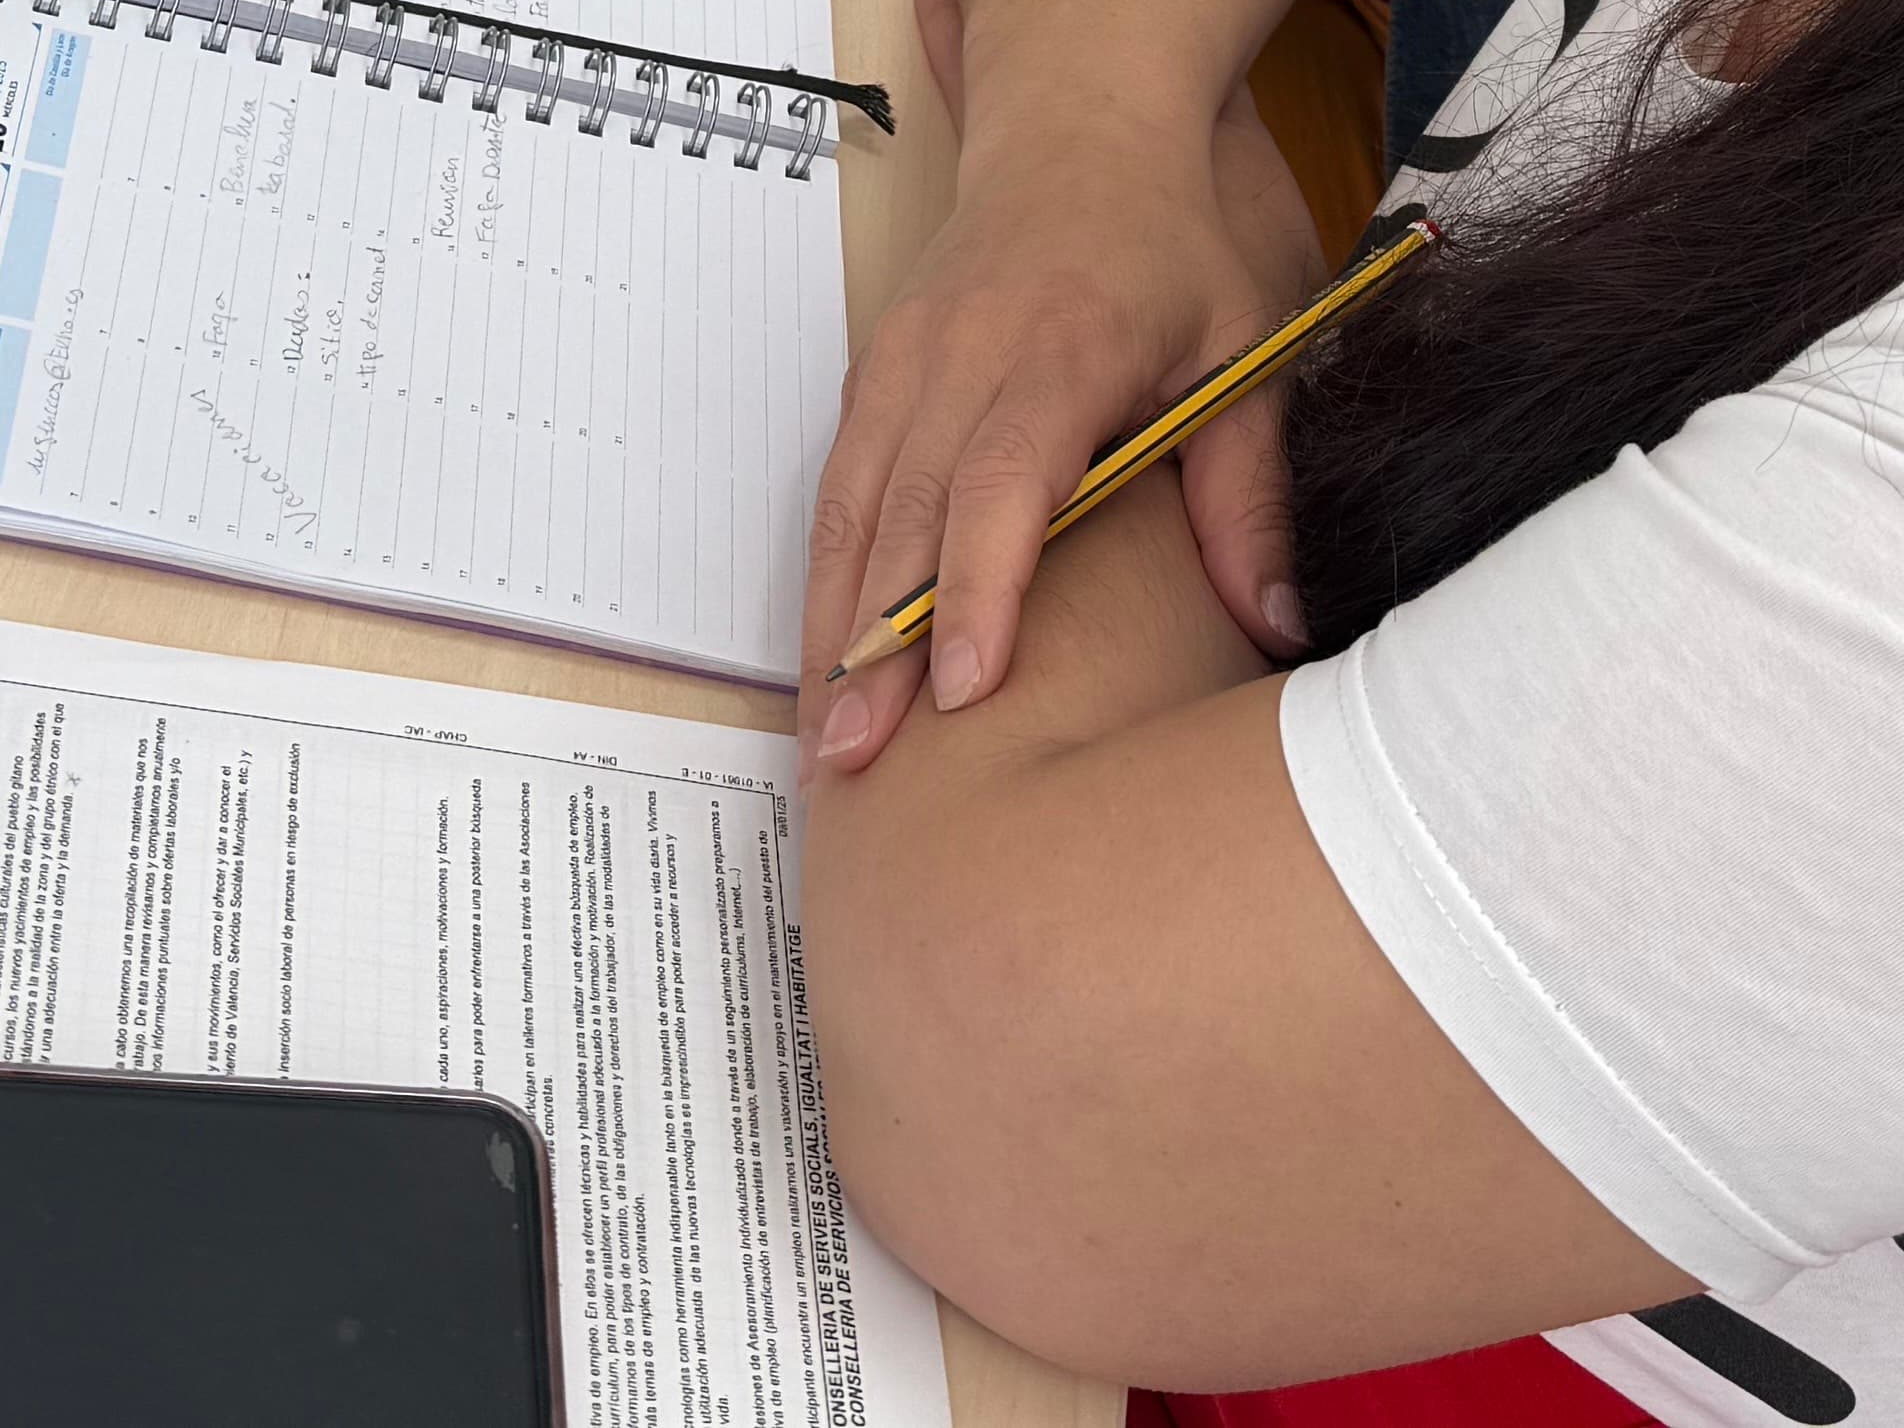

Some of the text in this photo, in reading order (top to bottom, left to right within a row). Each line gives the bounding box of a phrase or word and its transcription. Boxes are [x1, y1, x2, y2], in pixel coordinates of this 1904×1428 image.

[789, 923, 808, 1012] HABITATGE
[797, 1030, 815, 1111] IGUALTAT
[806, 1115, 824, 1195] SOCIALS,
[812, 1200, 832, 1275] SERVEIS
[820, 1281, 835, 1306] DE
[842, 1299, 866, 1428] CONSELLERIA
